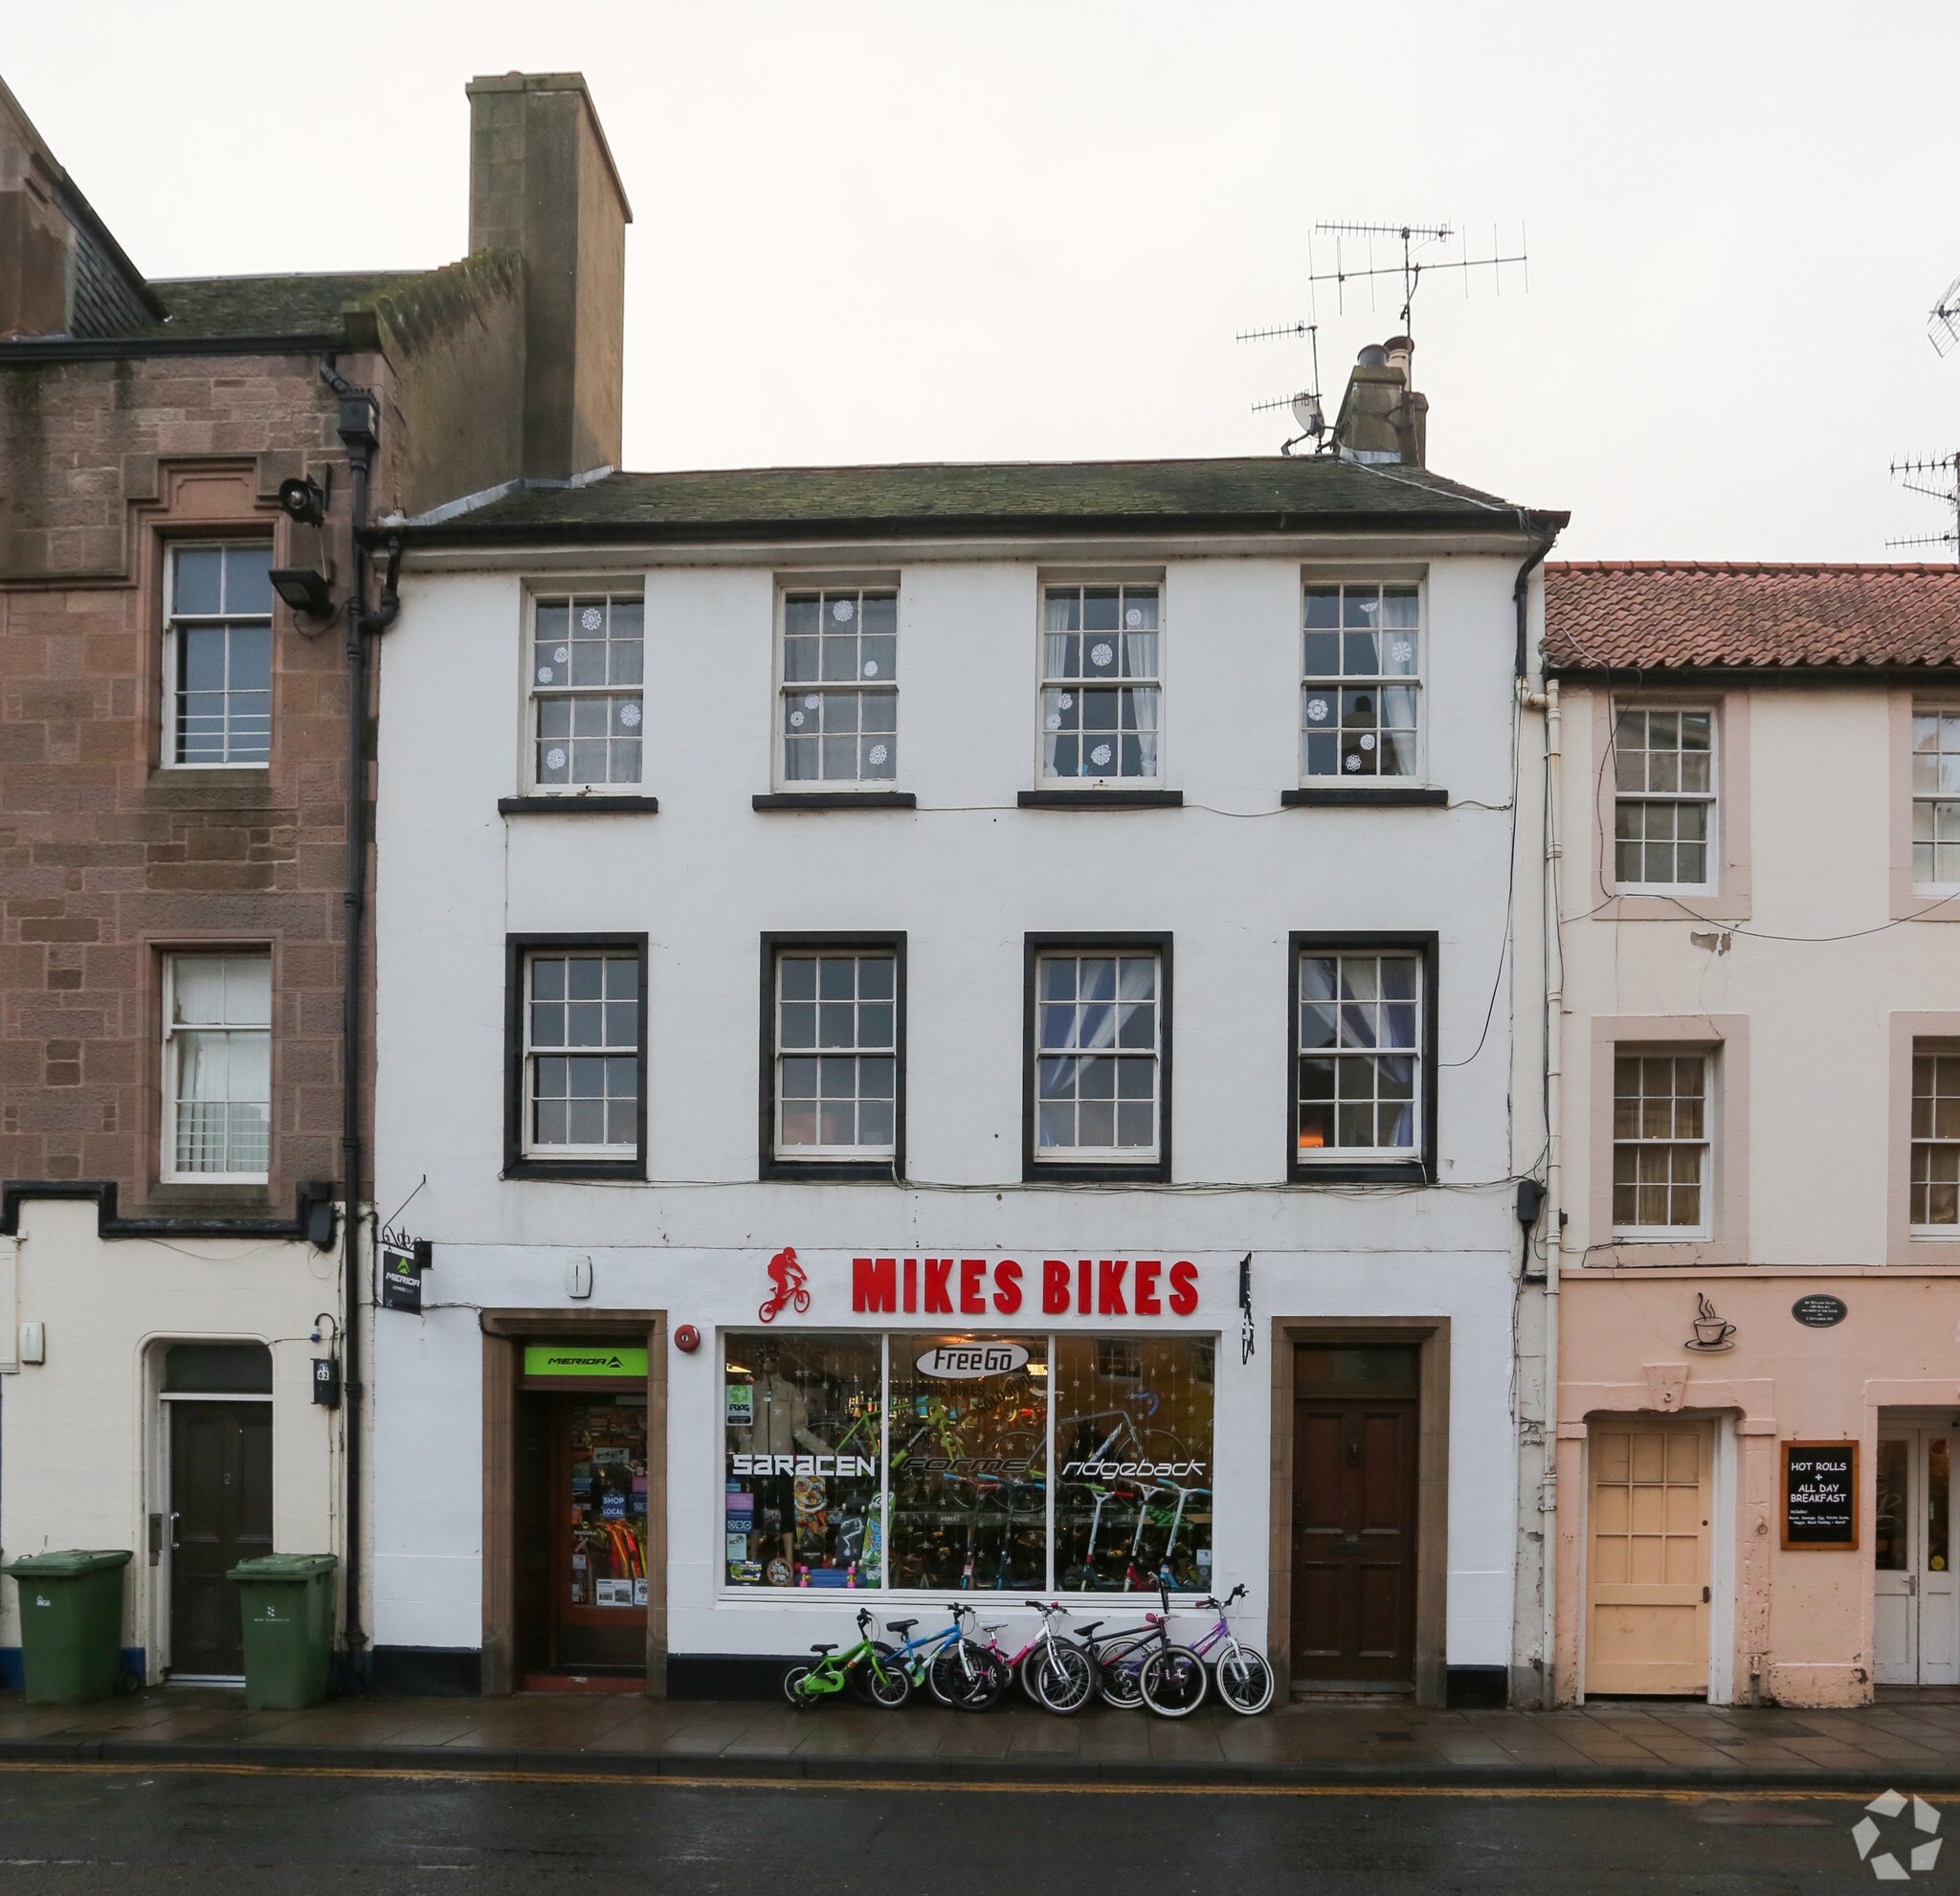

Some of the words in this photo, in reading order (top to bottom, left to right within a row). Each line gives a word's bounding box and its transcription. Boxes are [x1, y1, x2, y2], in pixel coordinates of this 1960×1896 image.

[386, 1272, 420, 1287] MERIDA
[853, 1258, 1023, 1315] MIKES
[1042, 1260, 1199, 1316] BIKES
[547, 1357, 608, 1366] MERIDA
[933, 1347, 1013, 1372] FreeGo
[950, 1384, 986, 1396] BIKES
[1061, 1459, 1207, 1480] ridgeback
[1791, 1462, 1813, 1471] HOT
[1815, 1462, 1847, 1471] ROLLS
[224, 1473, 232, 1484] 2
[1798, 1483, 1816, 1493] ALL
[1819, 1483, 1839, 1493] DAY
[1791, 1493, 1847, 1503] BREAKFAST
